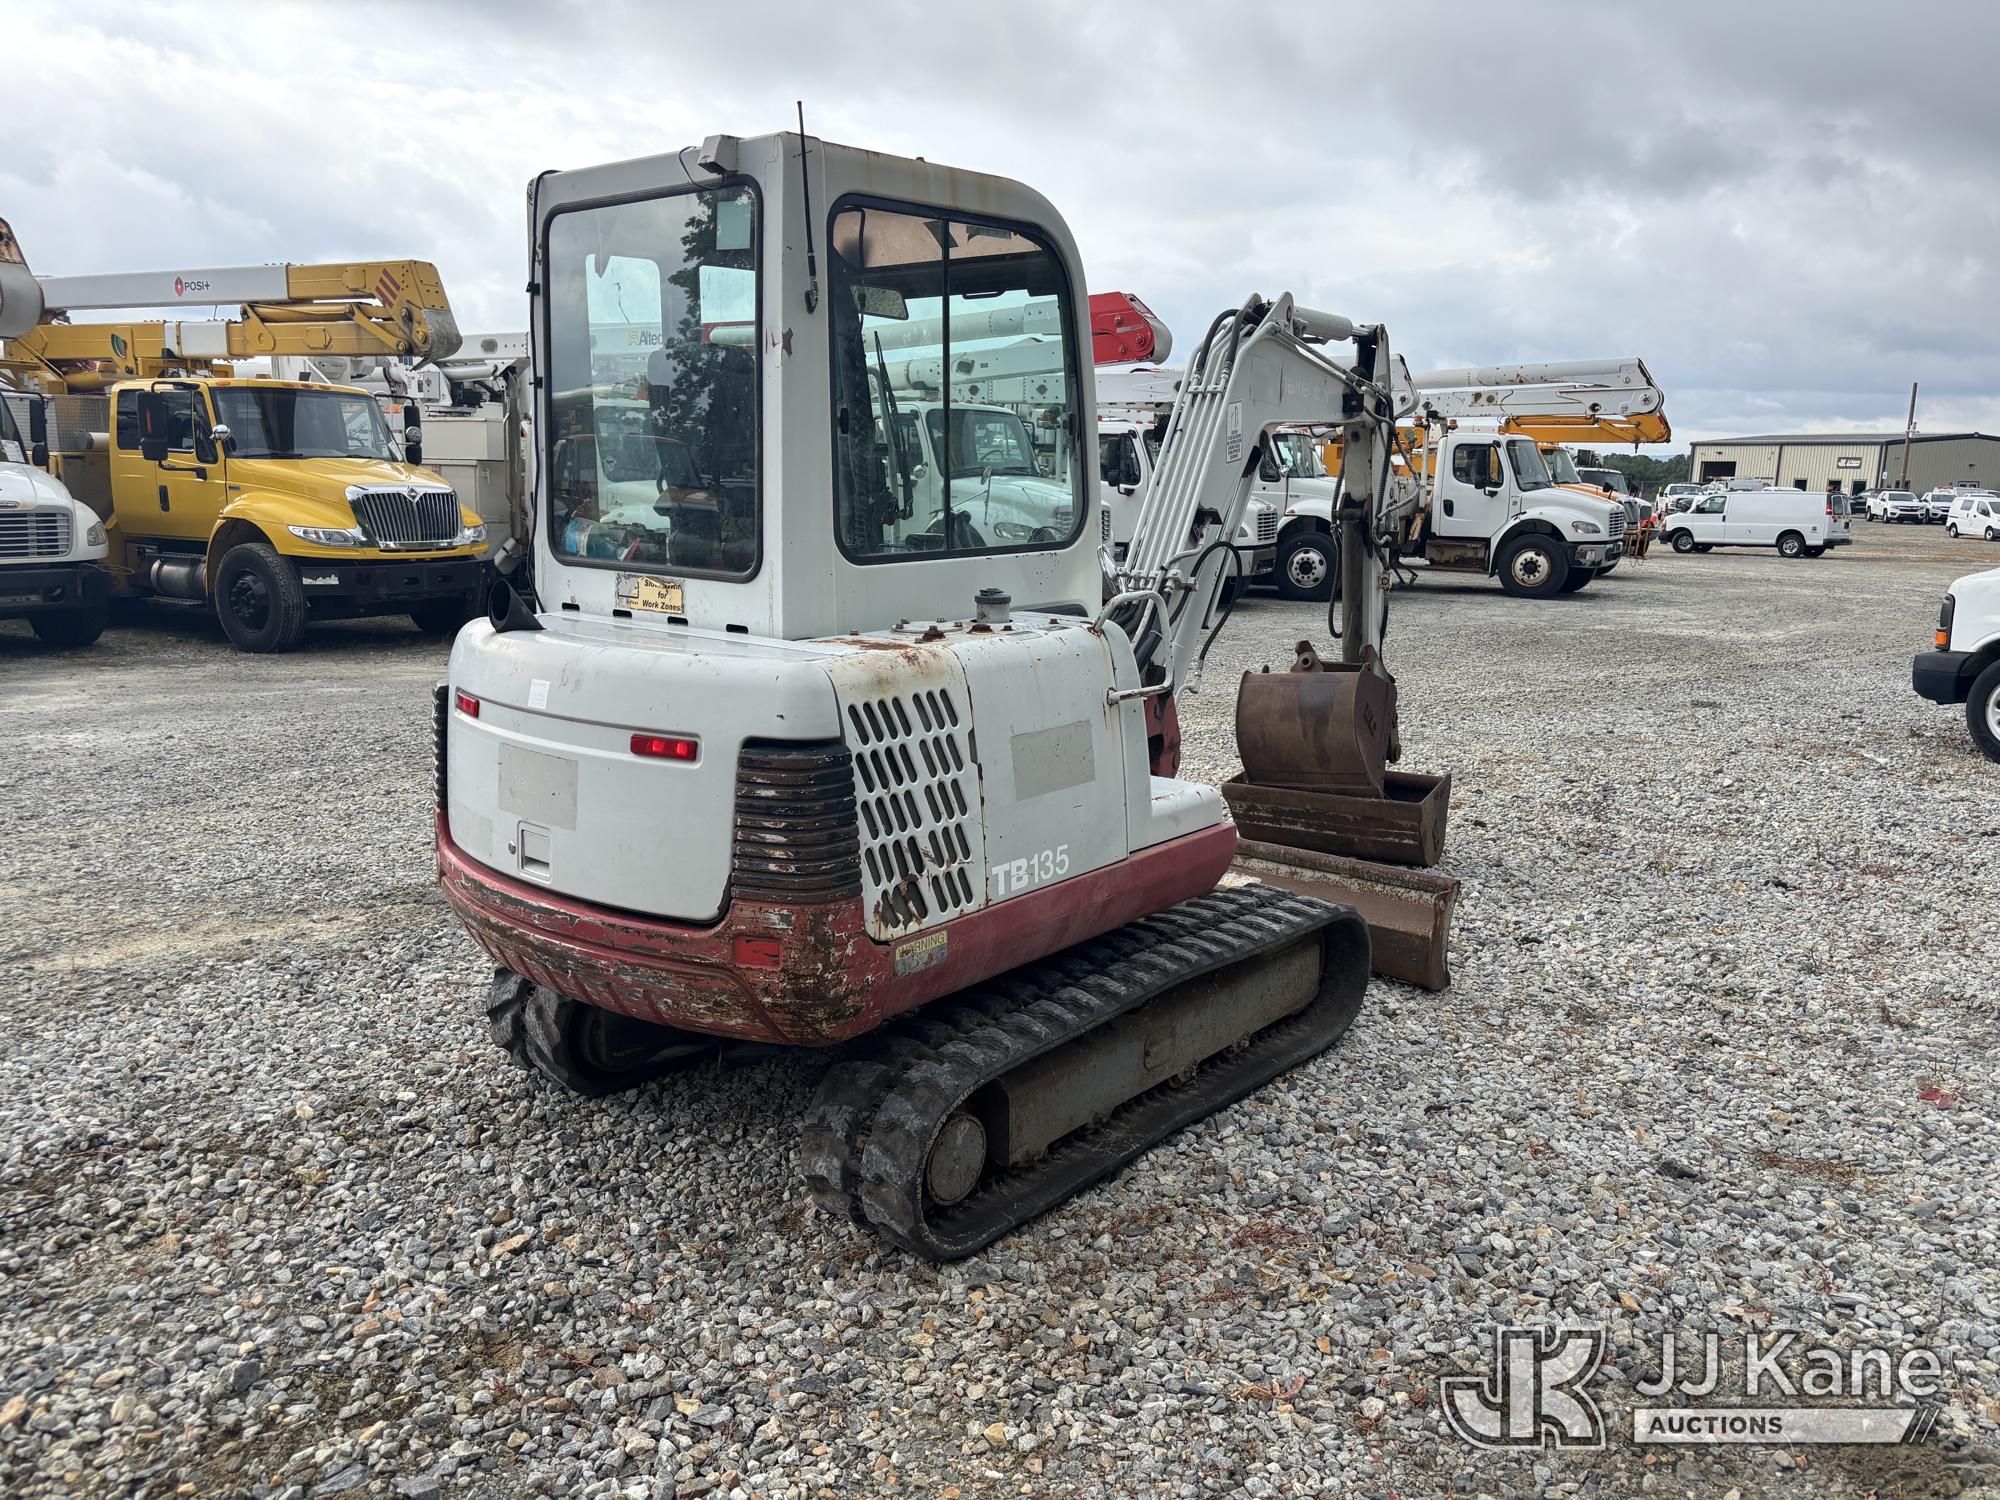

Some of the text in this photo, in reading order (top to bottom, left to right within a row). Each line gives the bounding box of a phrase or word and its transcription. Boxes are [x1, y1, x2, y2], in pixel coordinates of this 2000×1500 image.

[642, 600, 659, 609] Work
[660, 602, 681, 612] Zones
[991, 844, 1070, 896] TB135
